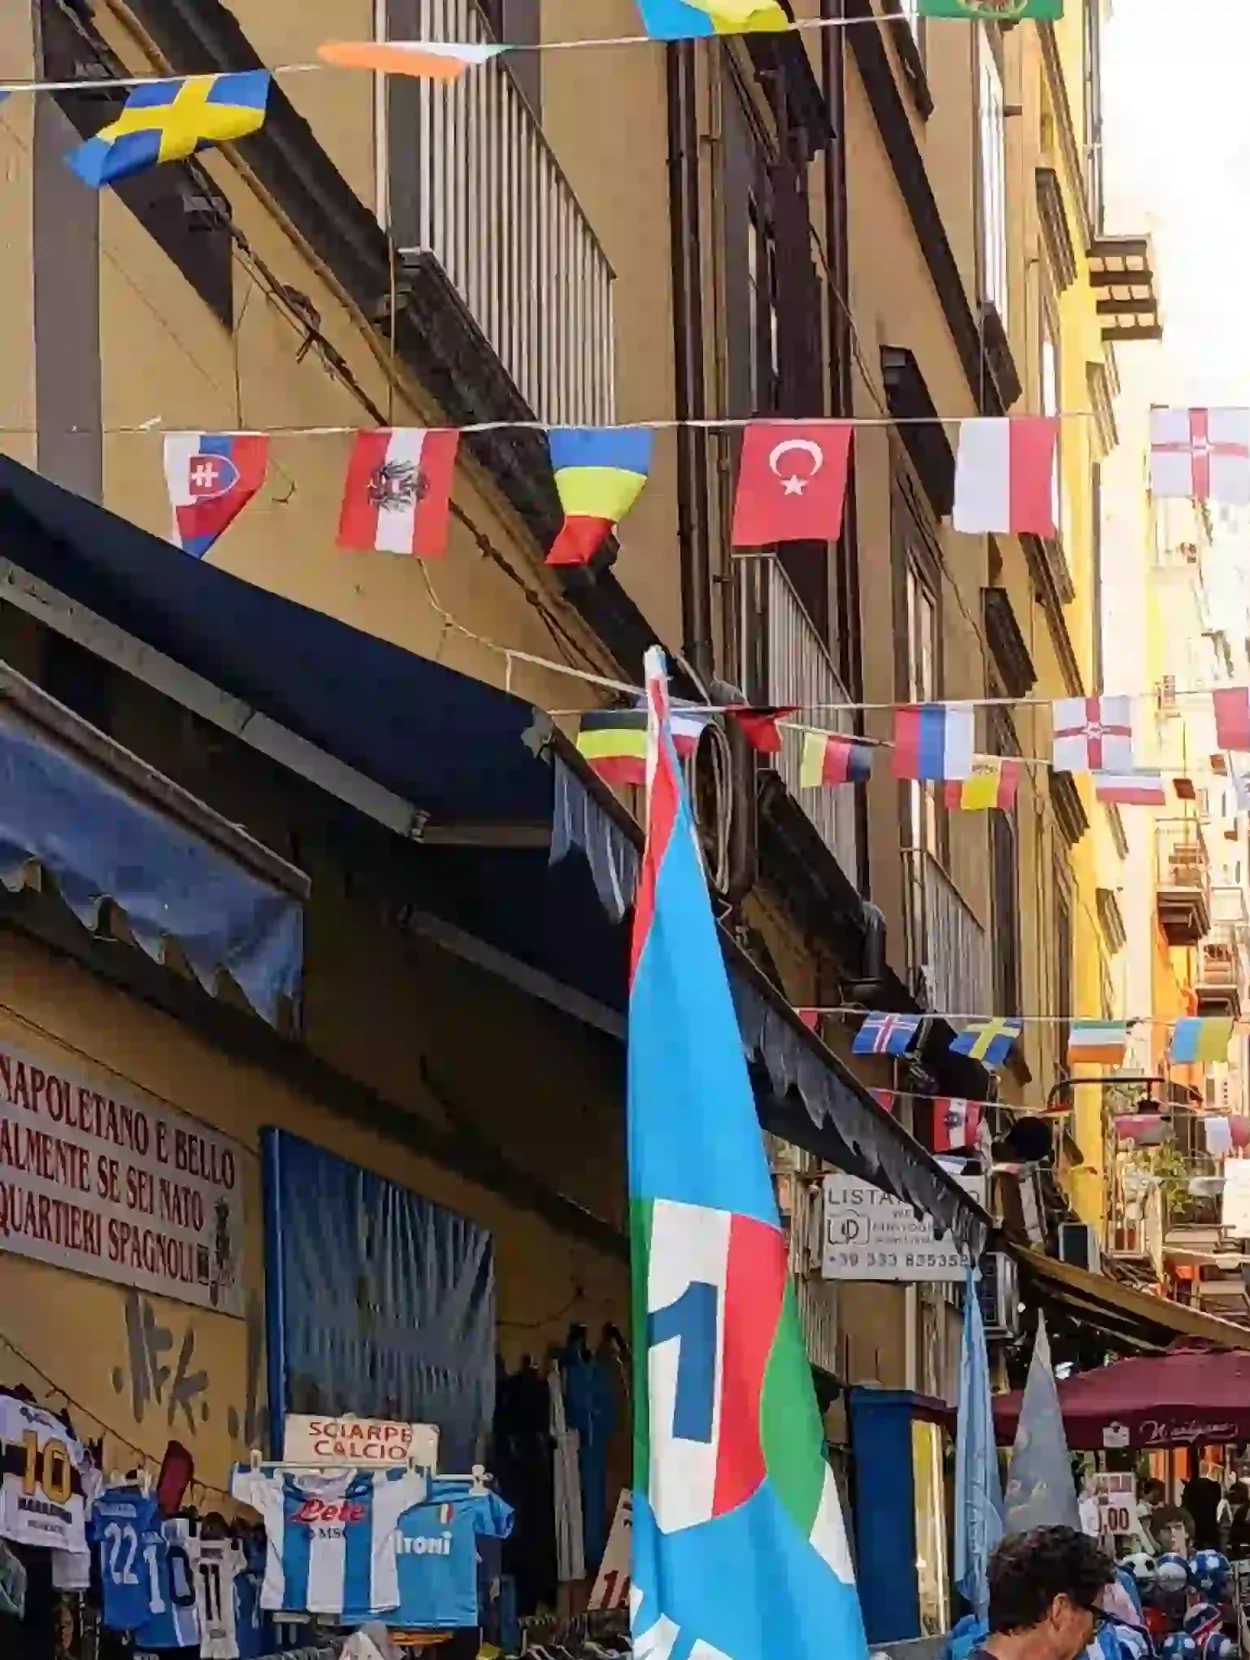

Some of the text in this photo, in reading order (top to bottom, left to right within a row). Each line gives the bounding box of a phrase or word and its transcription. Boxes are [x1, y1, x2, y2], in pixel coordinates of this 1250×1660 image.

[156, 1117, 169, 1164] E
[175, 1128, 236, 1190] BELLO
[97, 1154, 121, 1204] SE
[126, 1165, 155, 1215] SEI
[159, 1177, 205, 1232] NATO
[107, 1217, 194, 1284] SPAGNOLI
[22, 1428, 72, 1505] 10
[308, 1421, 413, 1461] SCIARPE CALCIO
[104, 1522, 140, 1585] 22
